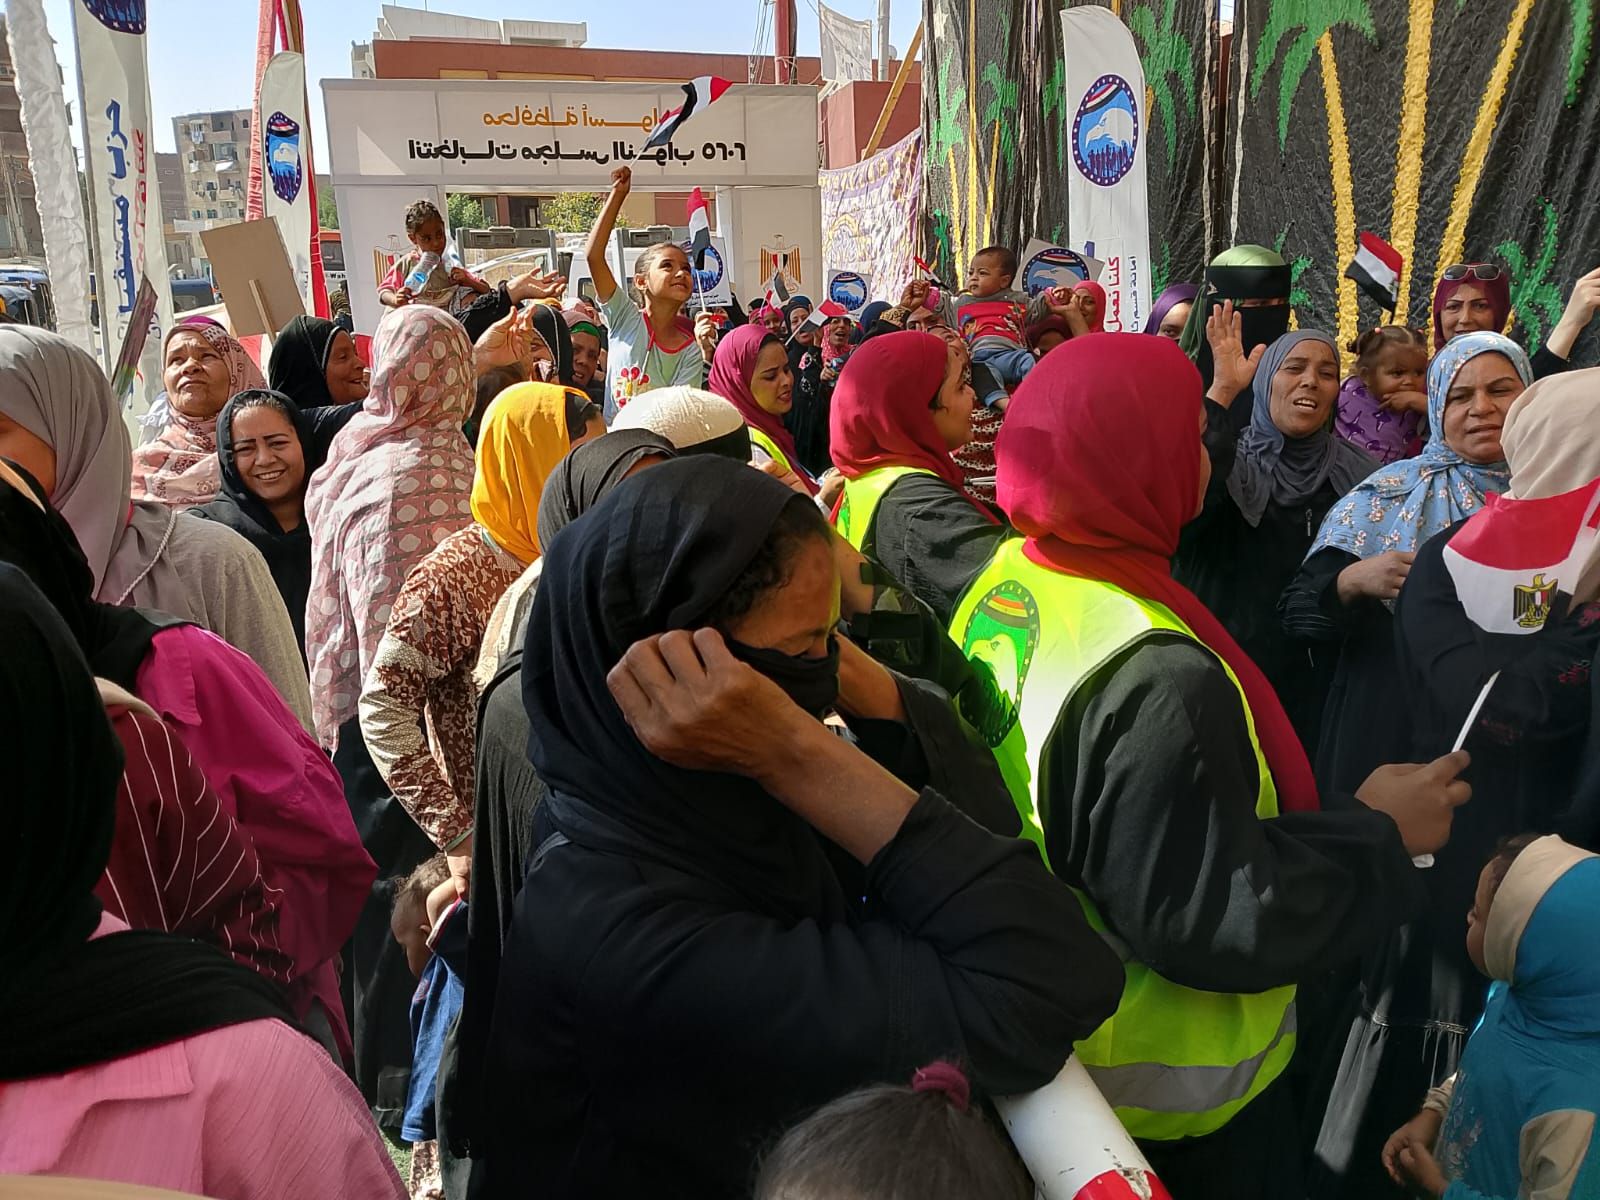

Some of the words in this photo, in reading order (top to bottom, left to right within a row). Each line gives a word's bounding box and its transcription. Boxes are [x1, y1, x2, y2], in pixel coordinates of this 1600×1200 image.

[106, 99, 131, 179] حزب
[1107, 256, 1120, 287] كلنا
[1106, 290, 1123, 332] نعمل
